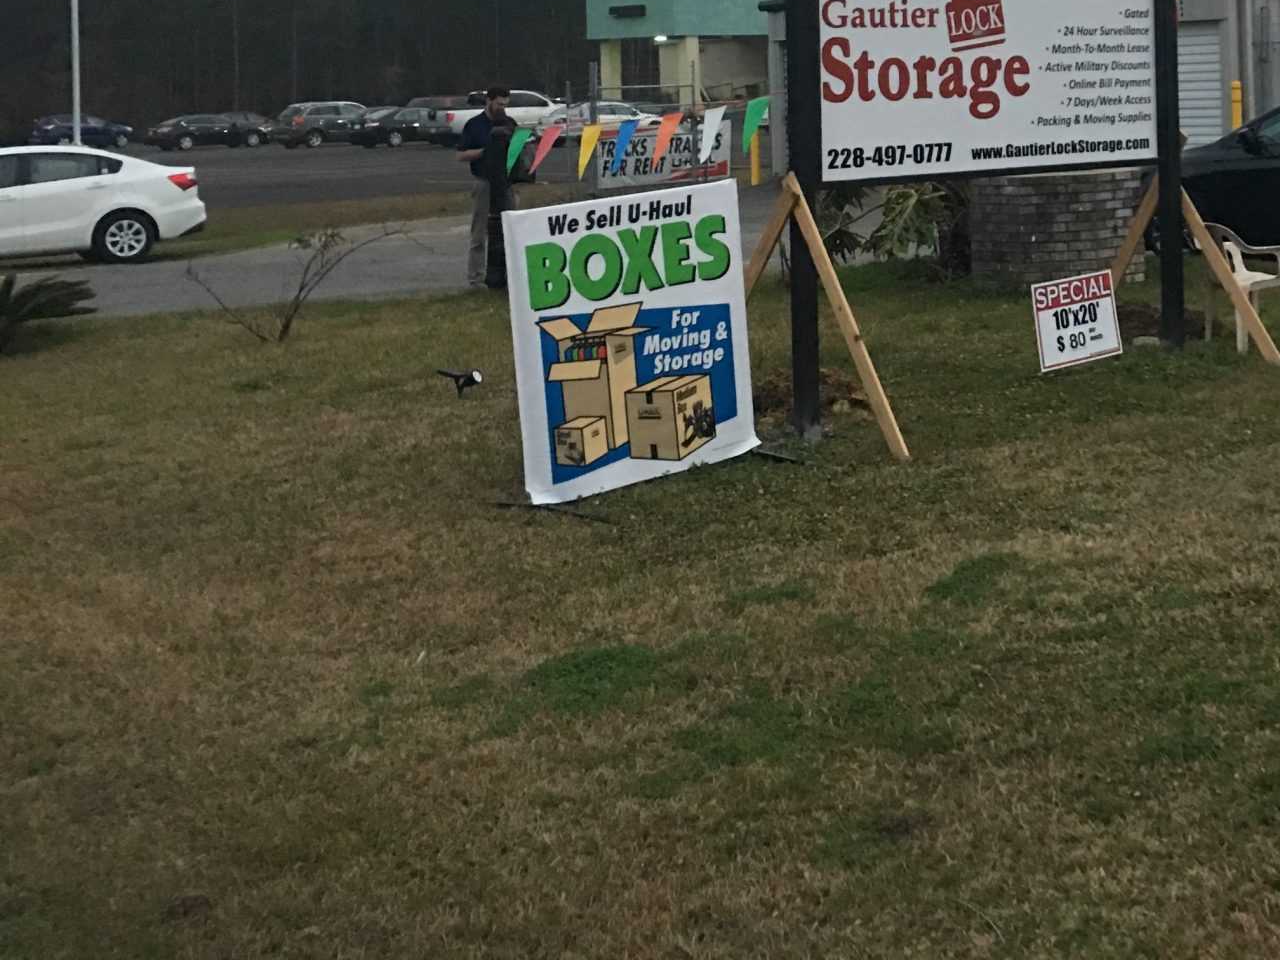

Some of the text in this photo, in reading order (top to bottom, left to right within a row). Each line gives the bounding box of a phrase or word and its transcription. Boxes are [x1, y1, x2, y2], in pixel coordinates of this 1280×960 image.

[949, 4, 1002, 36] LOCK
[1124, 8, 1150, 18] Gated
[1064, 25, 1150, 36] 24 Hour Surveillance
[1051, 43, 1150, 54] Month-To-Month Lease
[821, 37, 1031, 119] Storage
[1045, 60, 1151, 72] Active Military Discounts
[1068, 78, 1151, 89] Online Bill Payment
[1066, 95, 1152, 108] 7 Days/Week Access
[1037, 112, 1152, 128] Packing & Moving Supplies
[827, 138, 1150, 169] 228-497-0777 www.GautierLockStorage.com
[548, 195, 692, 236] We Sell U-Haul
[524, 214, 731, 312] BOXES
[1035, 275, 1111, 309] SPECIAL
[671, 309, 701, 329] For
[1052, 301, 1100, 331] 10'x20'
[643, 323, 711, 356] Moving
[715, 321, 728, 340] &
[1056, 335, 1066, 352] $
[1069, 331, 1086, 349] 80
[653, 346, 724, 375] Storage
